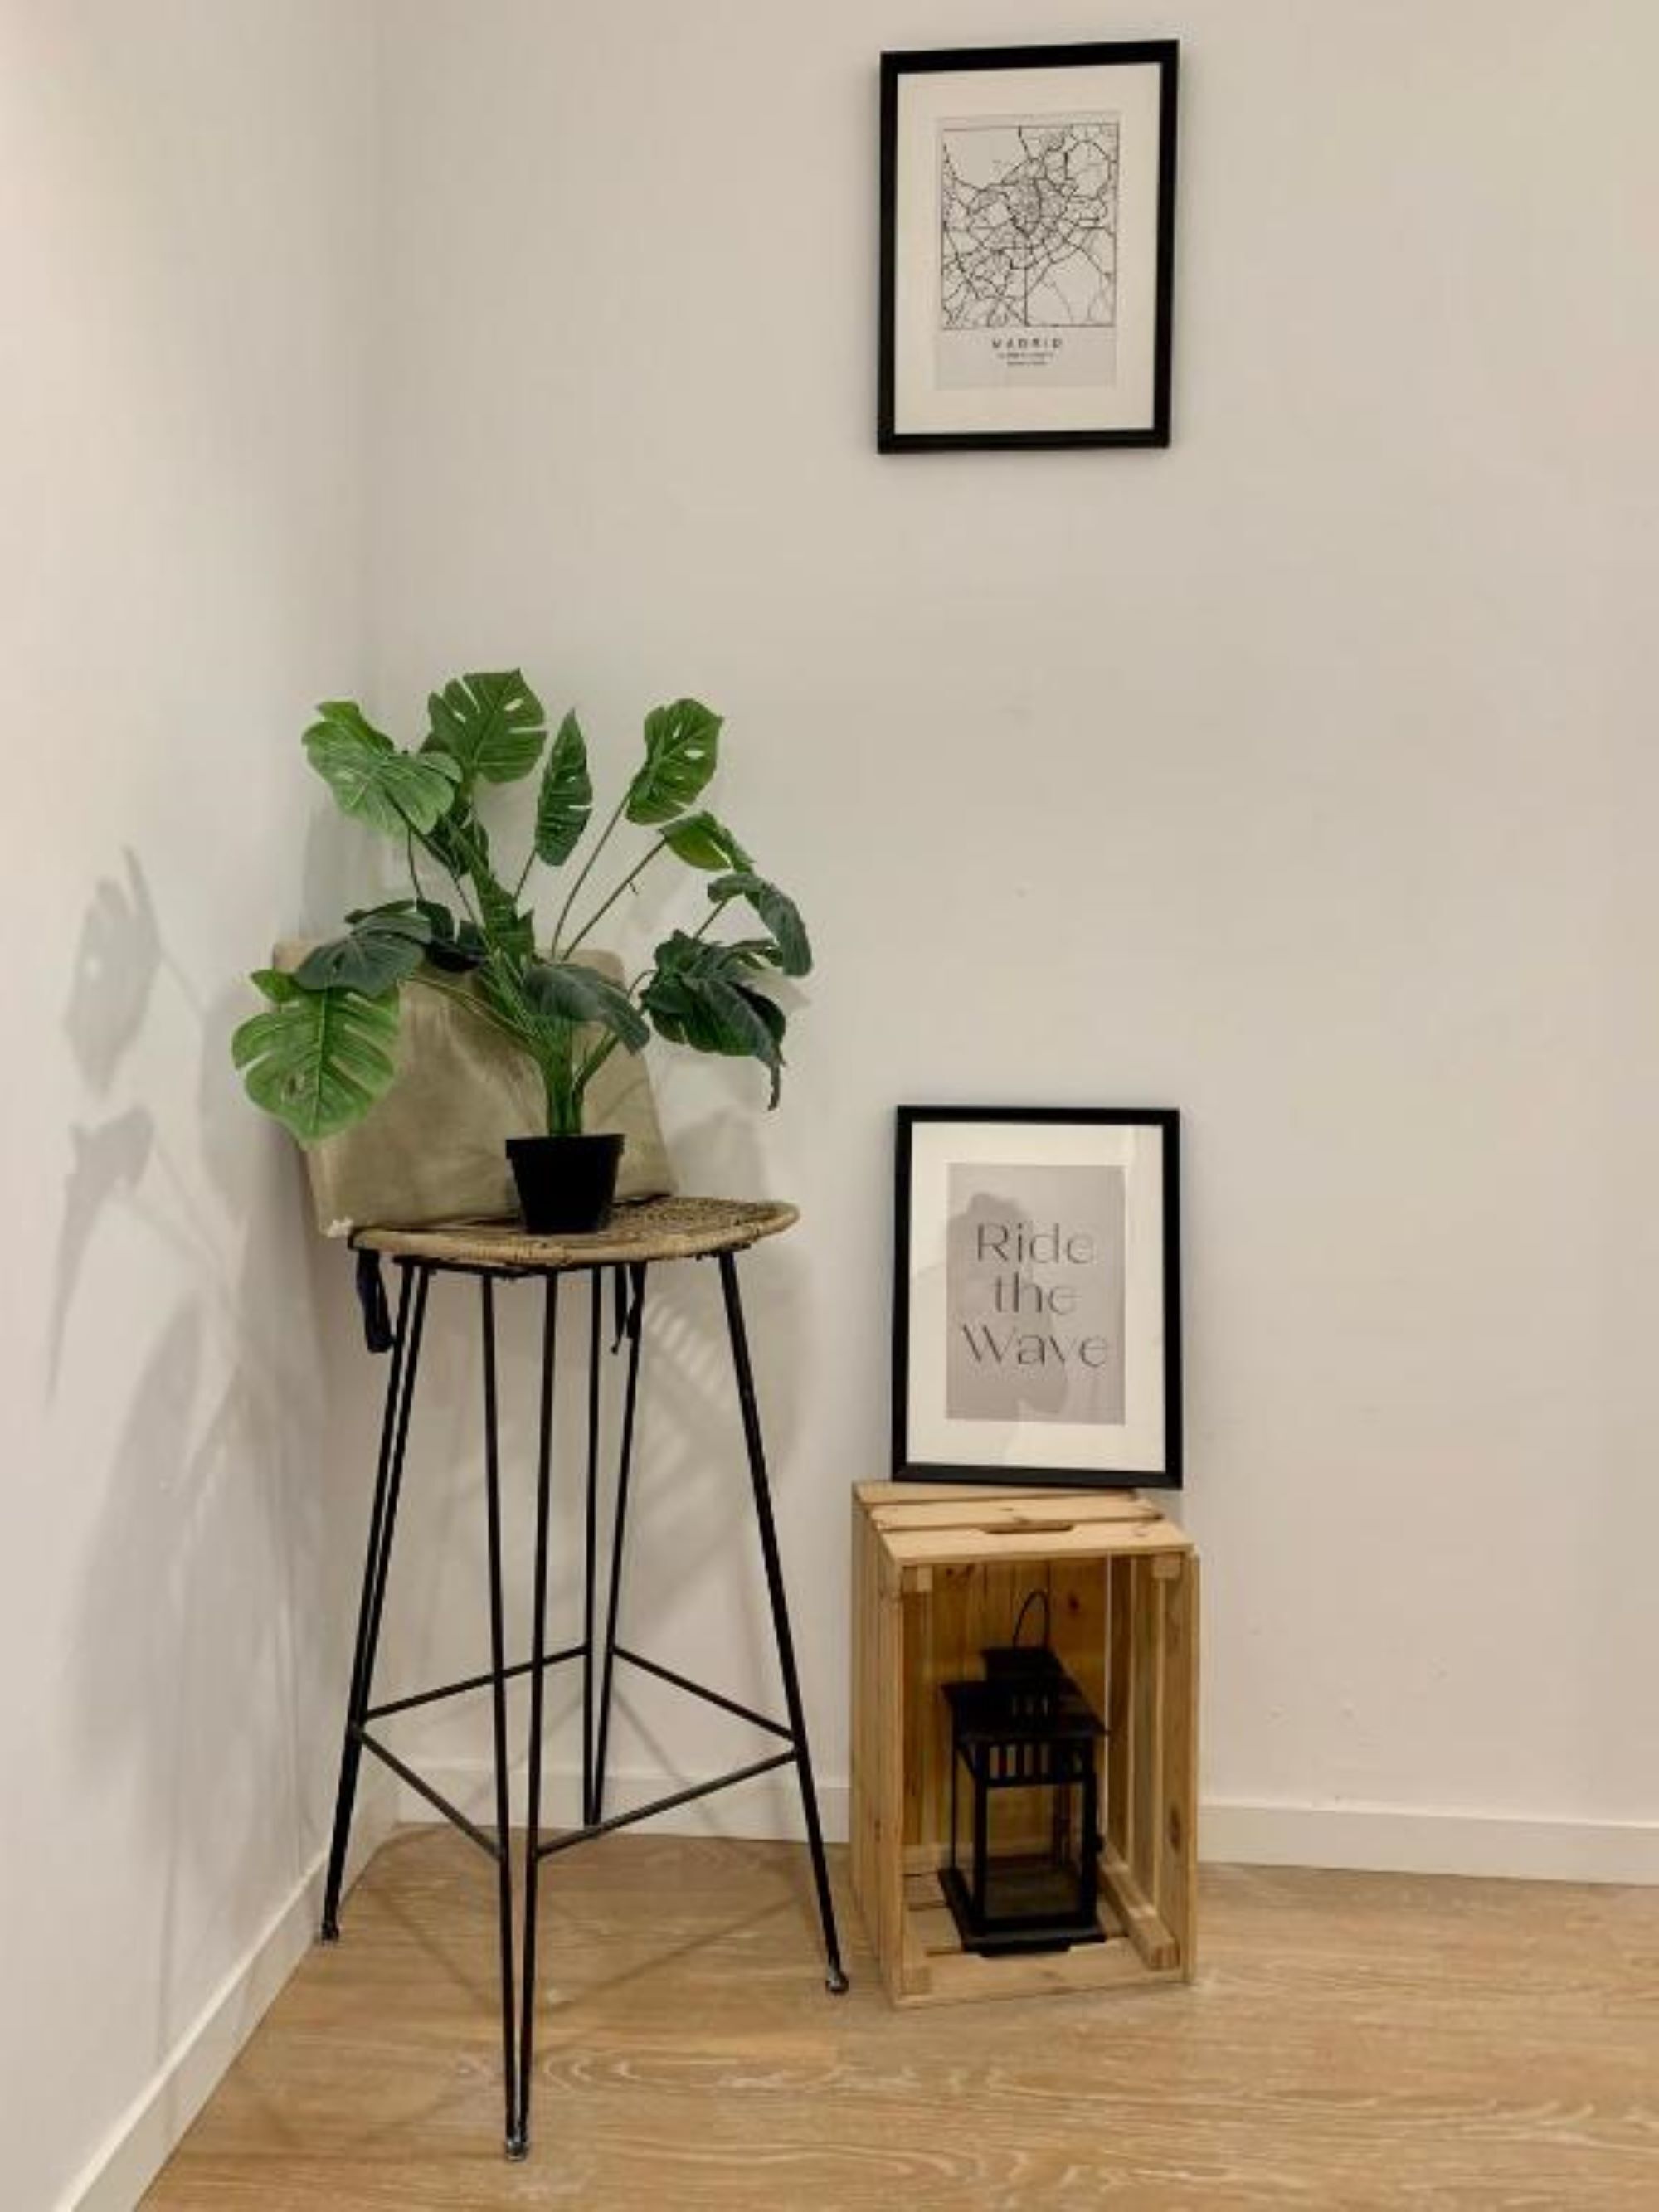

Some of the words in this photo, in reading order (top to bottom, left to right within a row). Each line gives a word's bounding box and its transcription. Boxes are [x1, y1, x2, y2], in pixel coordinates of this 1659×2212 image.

[992, 338, 1063, 349] MADRID
[977, 1223, 1094, 1264] Ride
[990, 1271, 1082, 1315] the
[962, 1323, 1107, 1368] Wave
